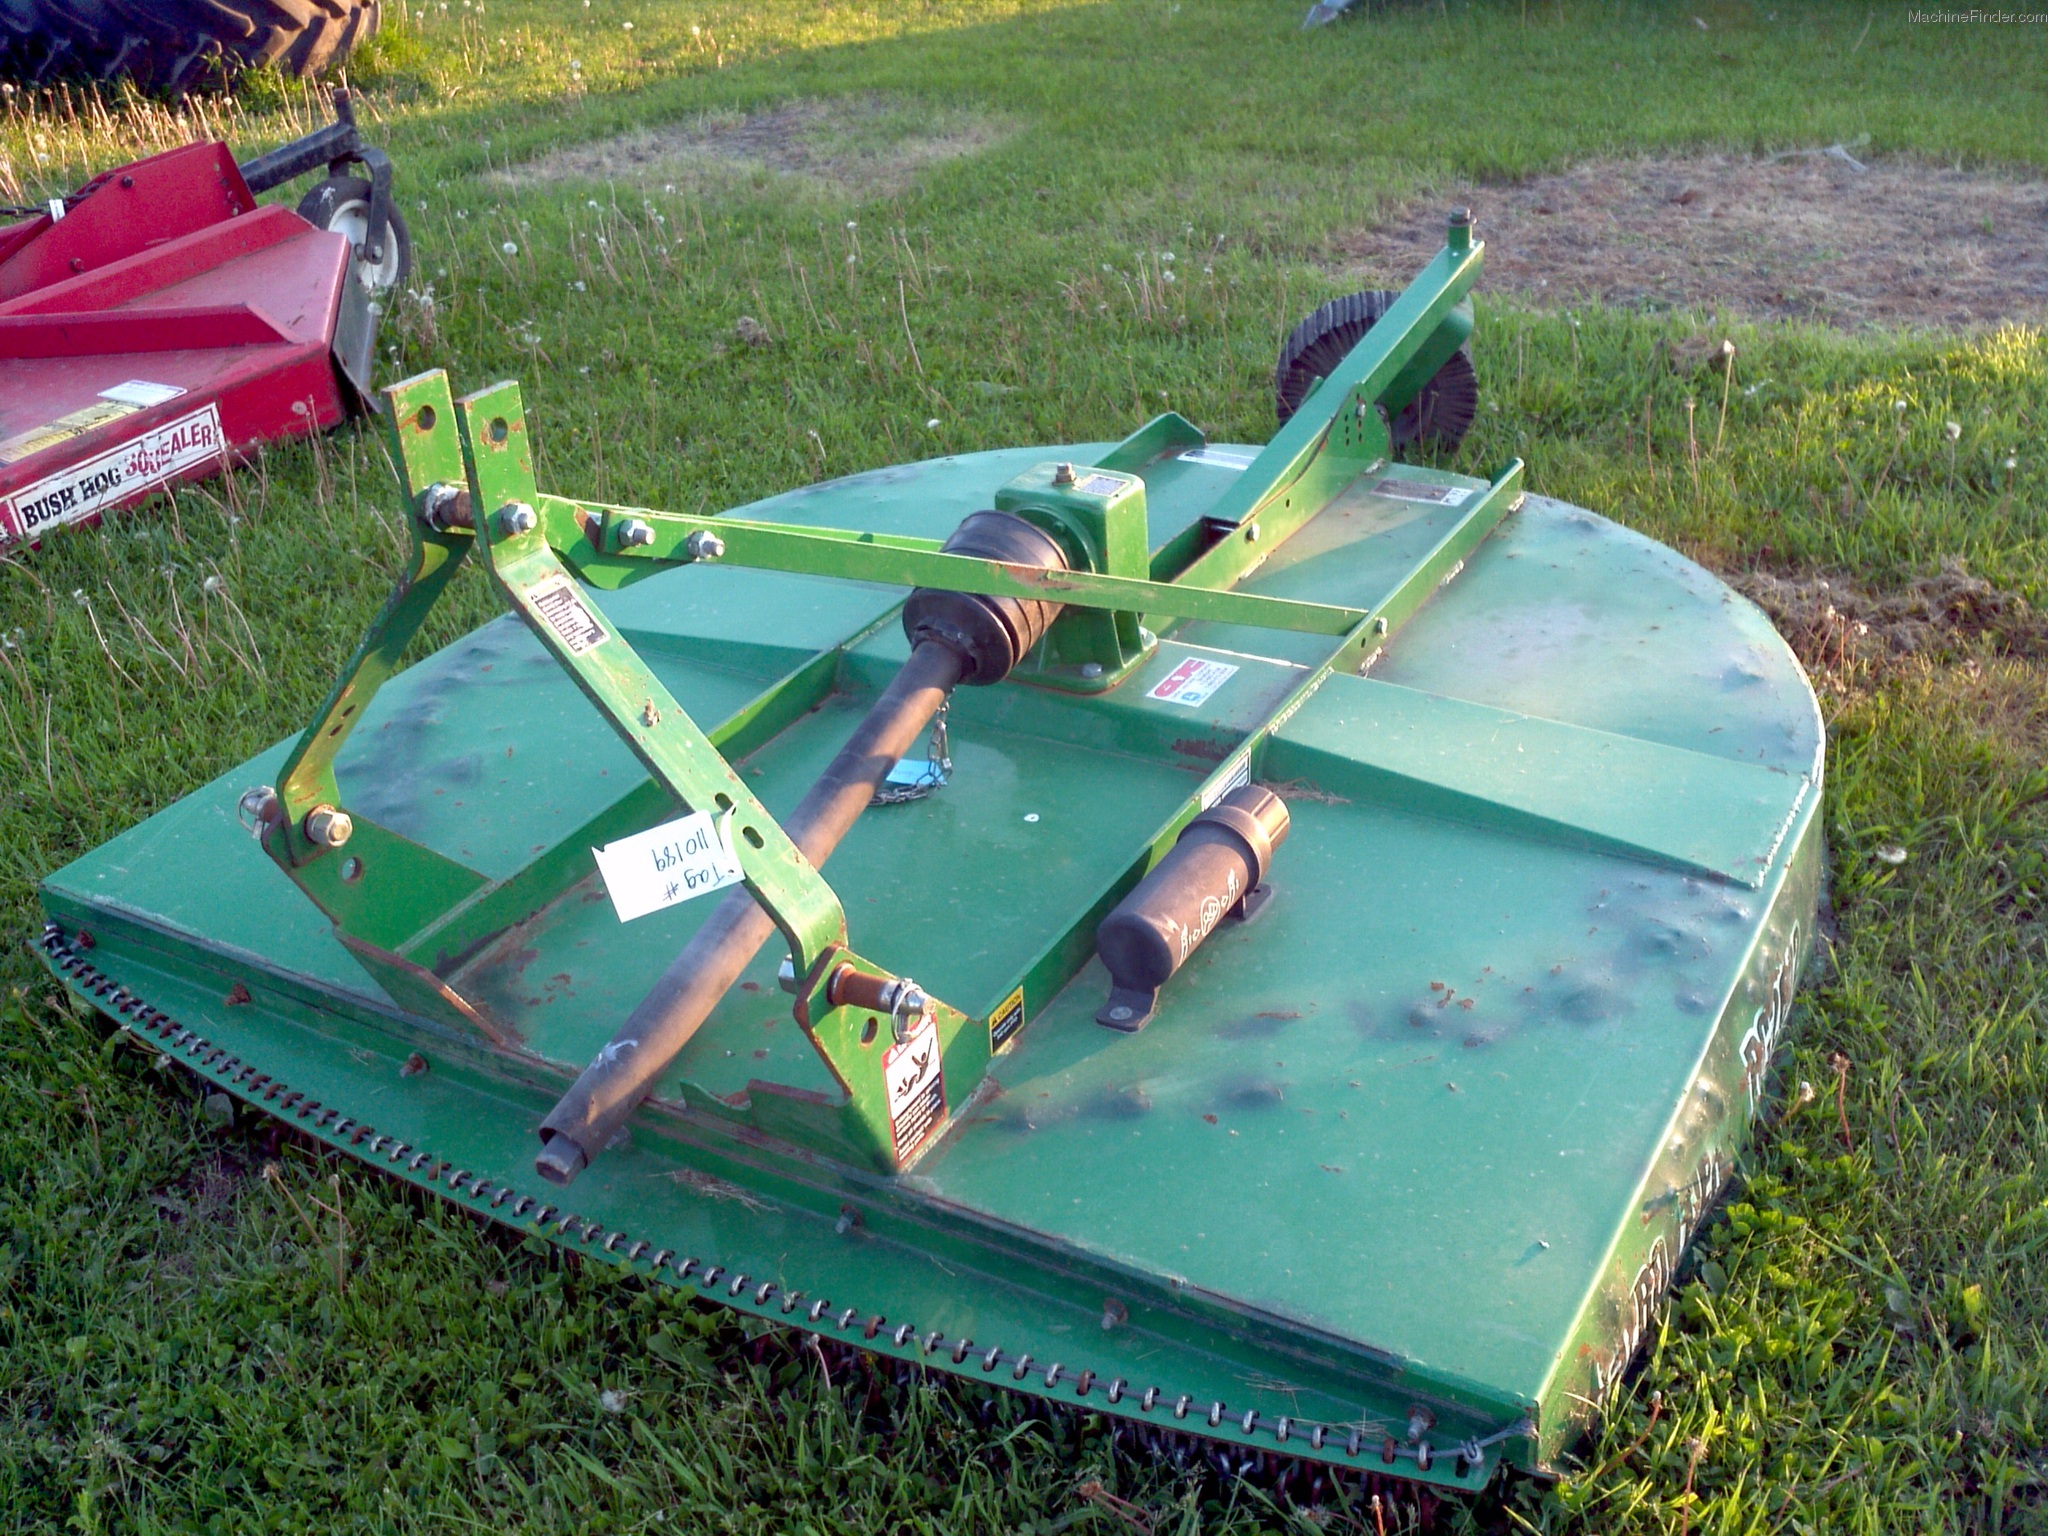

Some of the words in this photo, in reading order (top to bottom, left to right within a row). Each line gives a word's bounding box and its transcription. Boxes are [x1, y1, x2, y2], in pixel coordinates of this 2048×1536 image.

[21, 486, 78, 529] BUSH
[79, 466, 122, 501] HOG
[124, 422, 212, 477] SQUEALER
[651, 827, 709, 872] 110189
[684, 862, 725, 890] Tag
